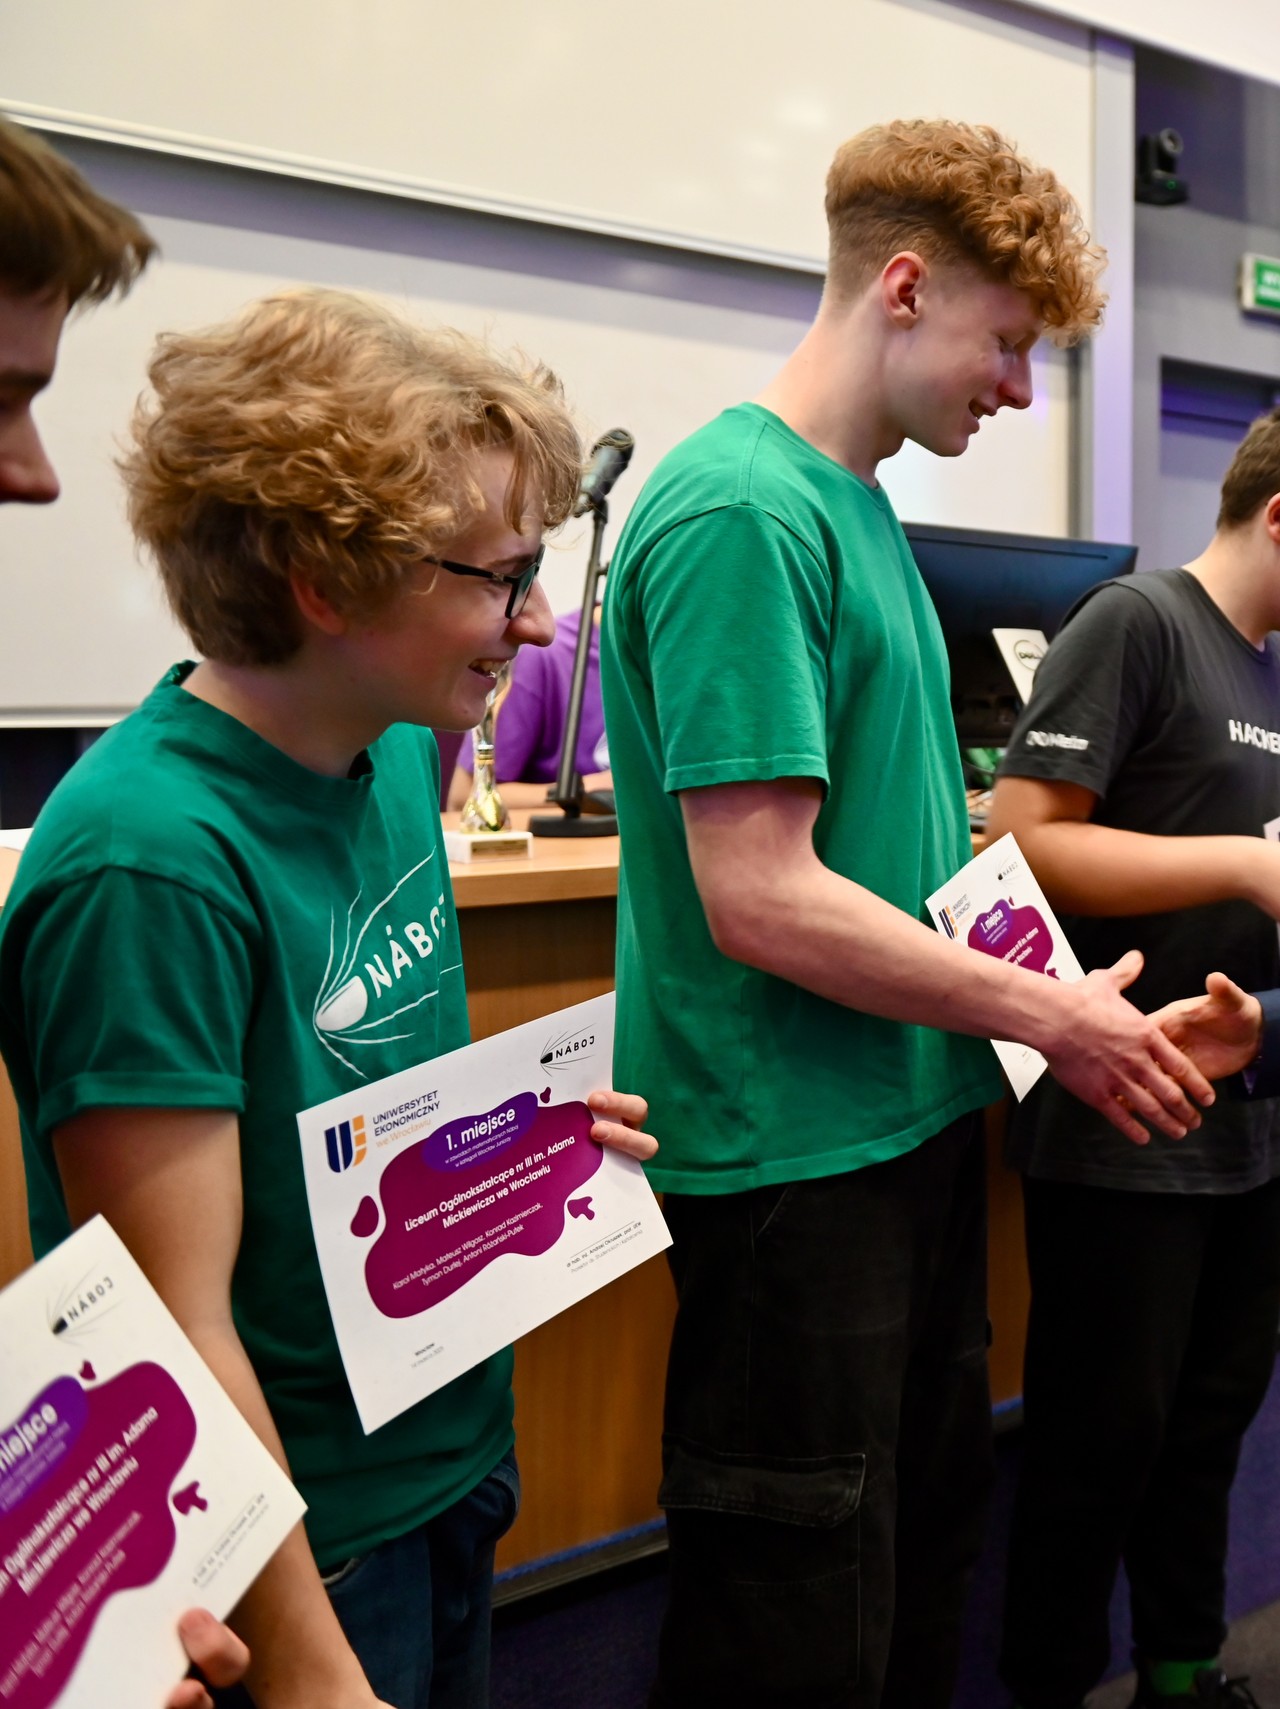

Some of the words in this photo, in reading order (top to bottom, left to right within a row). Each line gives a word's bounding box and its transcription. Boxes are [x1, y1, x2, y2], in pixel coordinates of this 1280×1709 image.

[555, 1035, 596, 1058] NÁBOJ
[372, 1090, 439, 1125] UNIWERSYTET
[374, 1101, 441, 1137] EKONOMICZNY
[376, 1138, 389, 1148] we
[446, 1133, 458, 1151] 1.
[460, 1108, 516, 1145] miejsce
[404, 1208, 439, 1232] Liceum
[439, 1166, 515, 1213] Ogólnokształcące
[515, 1161, 525, 1174] nr
[524, 1155, 533, 1168] III
[533, 1151, 546, 1164] im.
[547, 1135, 575, 1156] Adama
[442, 1195, 496, 1229] Mickiewicza
[496, 1186, 509, 1198] we
[509, 1164, 551, 1191] Wrocławiu
[392, 1275, 410, 1290] Karol
[436, 1247, 462, 1266] Mateusz
[485, 1222, 507, 1238] Konrad
[463, 1247, 483, 1263] Antoni
